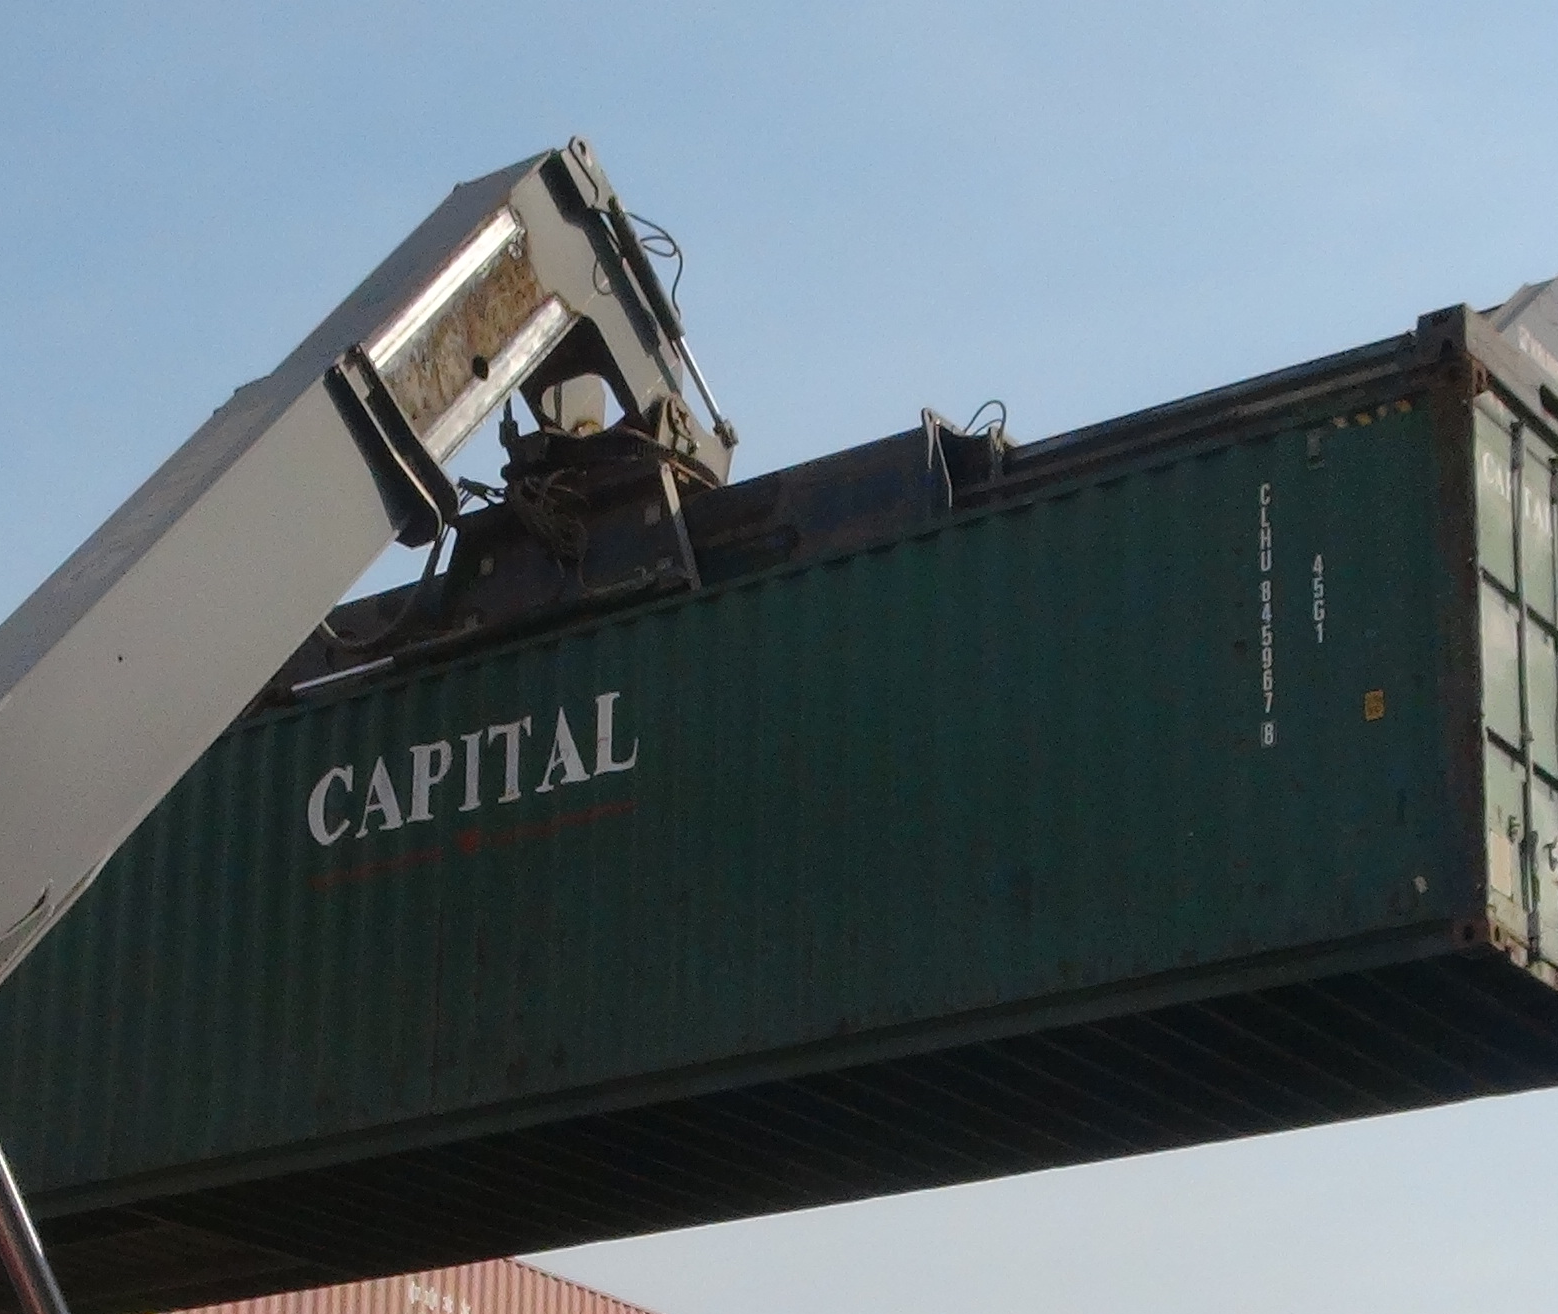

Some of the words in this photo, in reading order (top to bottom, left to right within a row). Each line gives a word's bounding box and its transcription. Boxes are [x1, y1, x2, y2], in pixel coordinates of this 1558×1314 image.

[1259, 483, 1272, 572] CLHU
[1260, 580, 1273, 714] 845967
[1312, 554, 1324, 644] 45G1
[307, 691, 640, 847] CAPITAL
